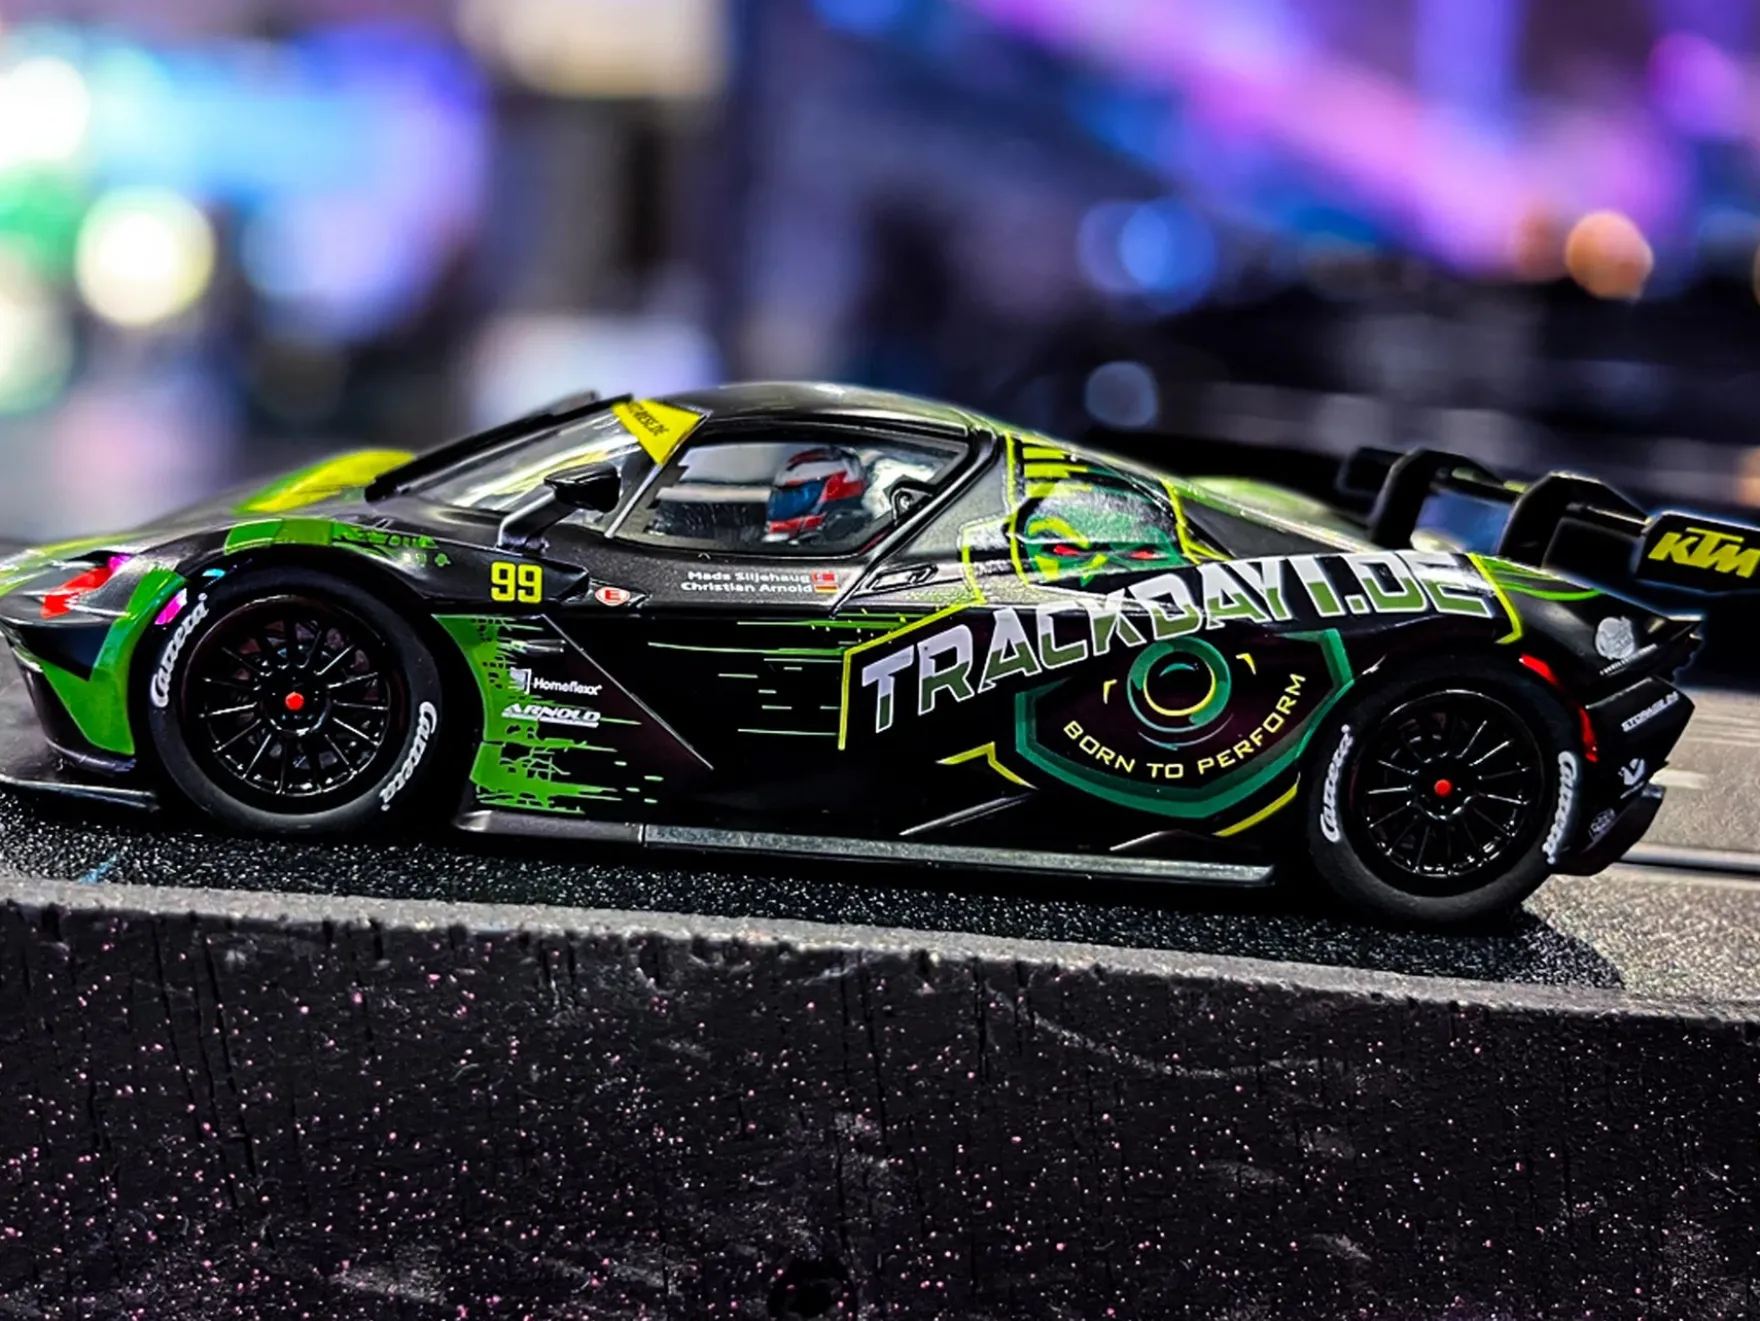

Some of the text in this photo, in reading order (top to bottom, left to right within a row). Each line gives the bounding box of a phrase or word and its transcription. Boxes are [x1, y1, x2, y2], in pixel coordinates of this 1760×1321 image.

[1648, 527, 1760, 578] KTM
[491, 561, 542, 604] 99
[680, 581, 813, 593] Christian Arnold
[687, 570, 732, 582] Mads
[501, 703, 601, 722] ARNOLD
[1063, 673, 1306, 779] BORN TO PERFORM
